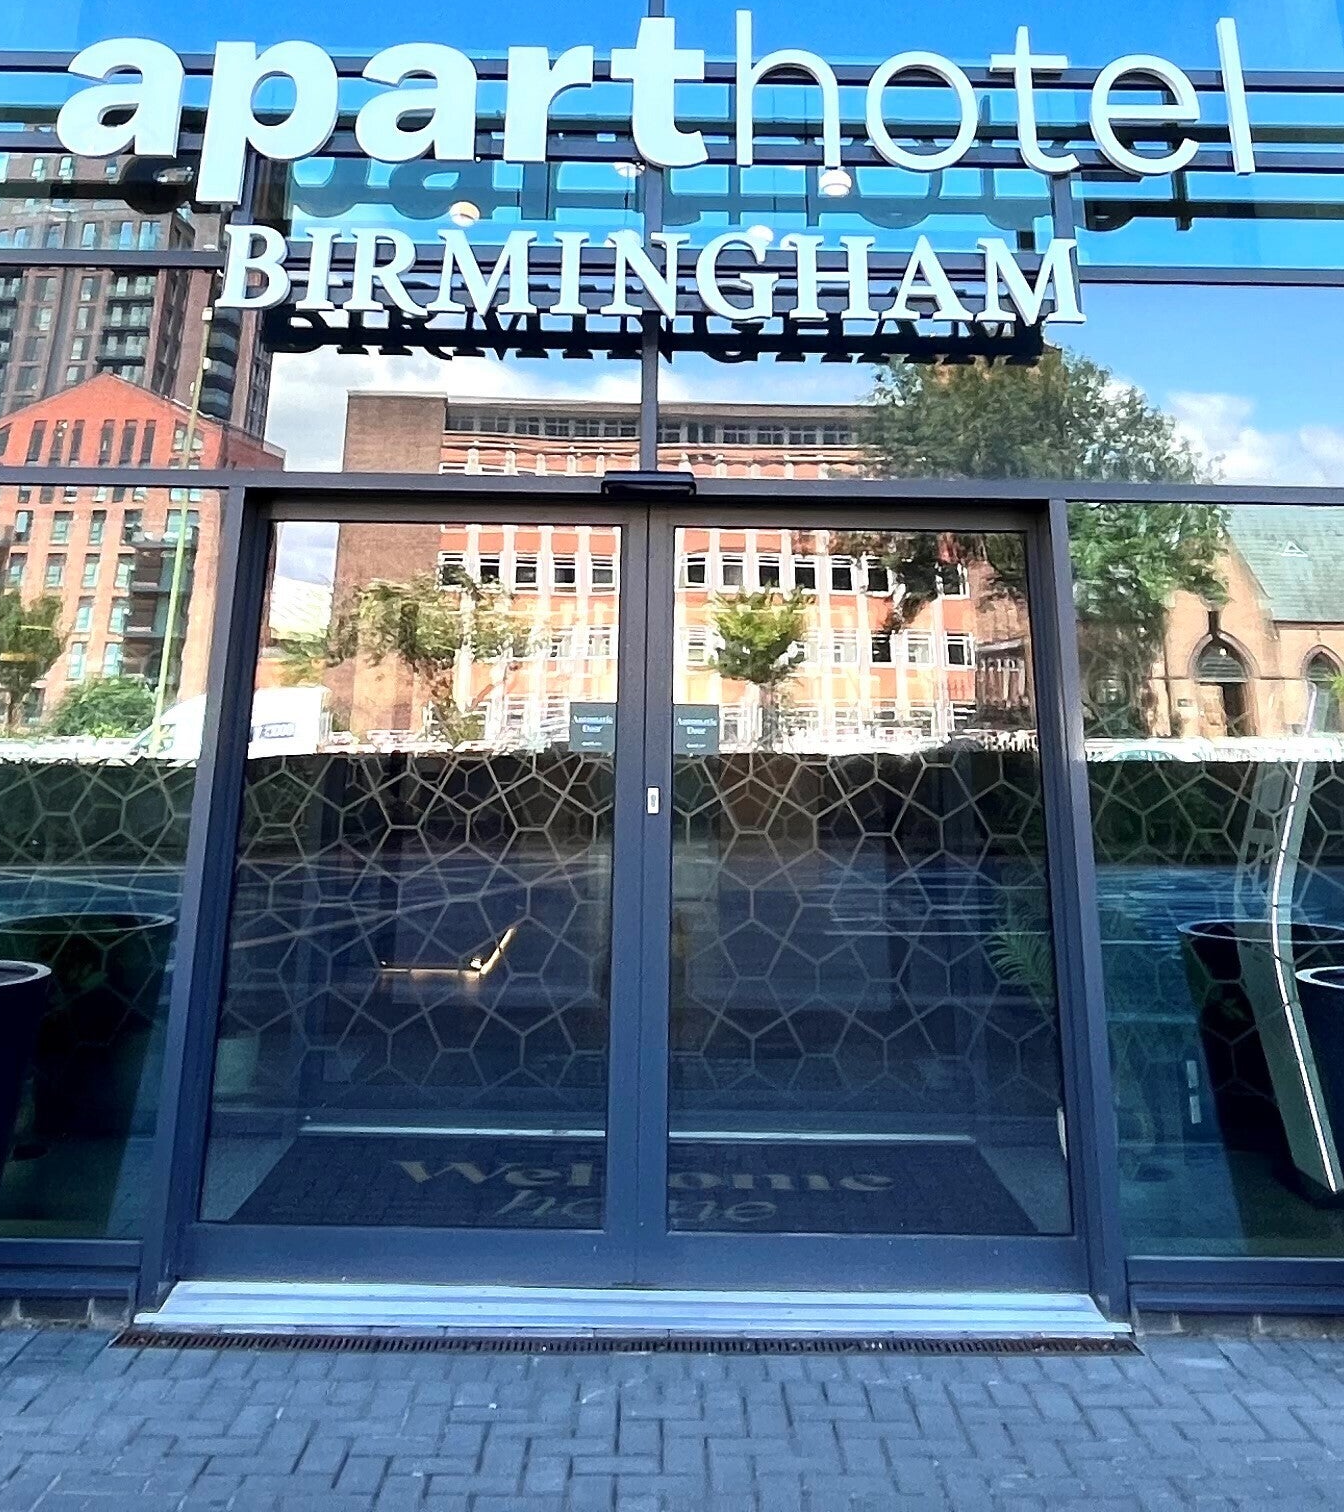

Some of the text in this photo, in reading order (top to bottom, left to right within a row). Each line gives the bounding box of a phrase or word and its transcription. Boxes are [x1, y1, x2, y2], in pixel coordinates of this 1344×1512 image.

[55, 9, 1256, 205] aparthotel
[214, 224, 1087, 327] BIRMINGHAM
[392, 1159, 895, 1191] Welome
